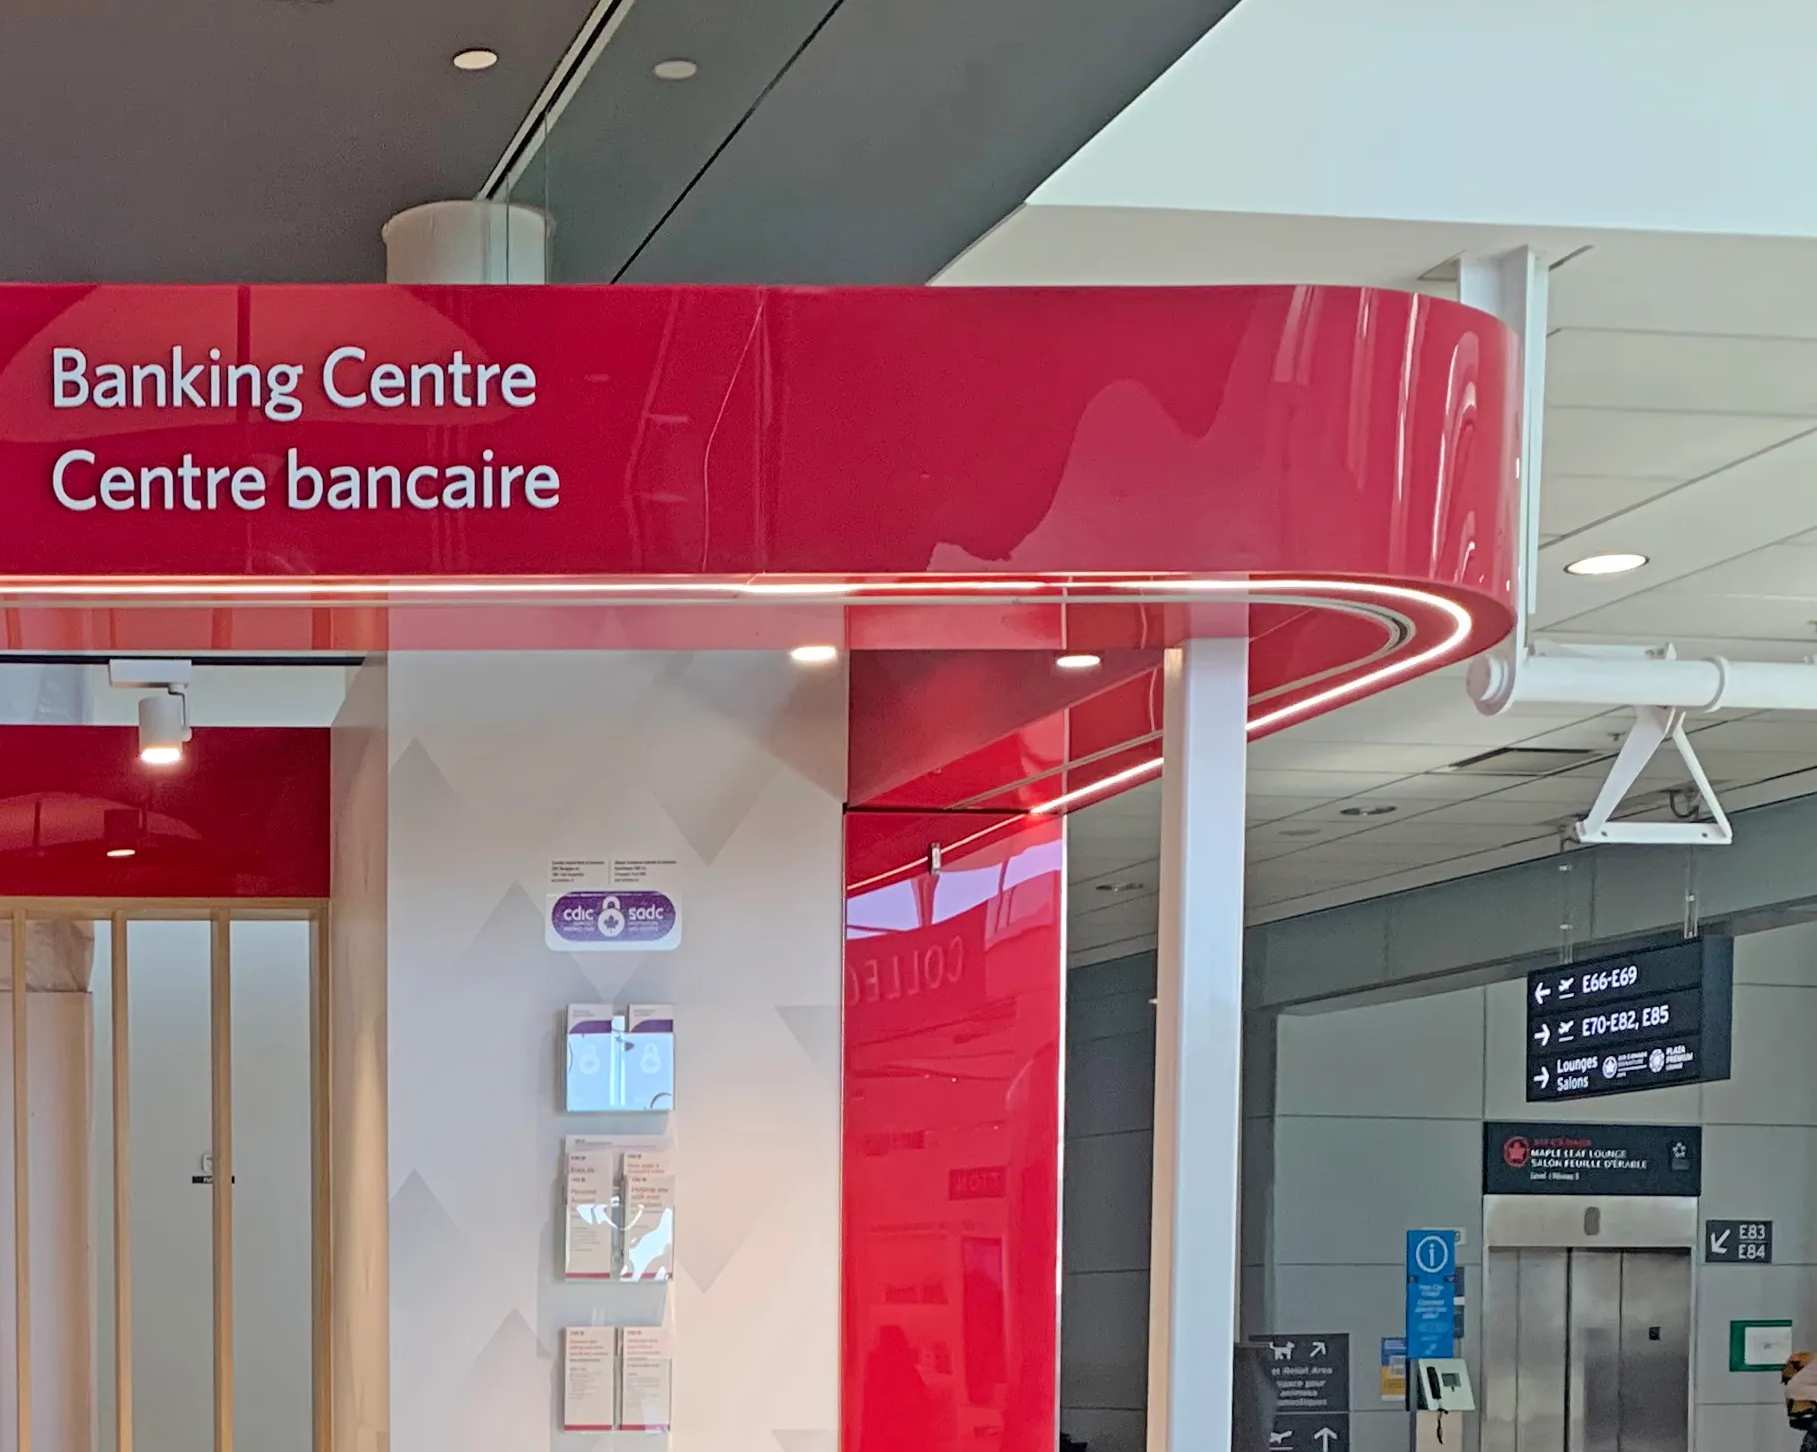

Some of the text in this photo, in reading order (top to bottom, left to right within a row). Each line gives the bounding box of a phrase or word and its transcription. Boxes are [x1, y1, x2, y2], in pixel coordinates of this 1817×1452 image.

[52, 345, 537, 422] Banking Centre
[52, 449, 561, 512] Centre bancaire
[563, 904, 594, 921] cdic
[629, 904, 664, 921] sadc
[1583, 966, 1638, 993] E66-E69
[1582, 1005, 1670, 1036] E70-E82, E85
[1557, 1056, 1598, 1074] Lounges
[1557, 1076, 1588, 1092] Salons
[1531, 1149, 1627, 1158] MAPLE LEAF LOUNGE
[1531, 1159, 1562, 1168] SALON
[1564, 1159, 1601, 1168] FEUILLE
[1739, 1224, 1766, 1240] E83
[1738, 1244, 1766, 1260] E84
